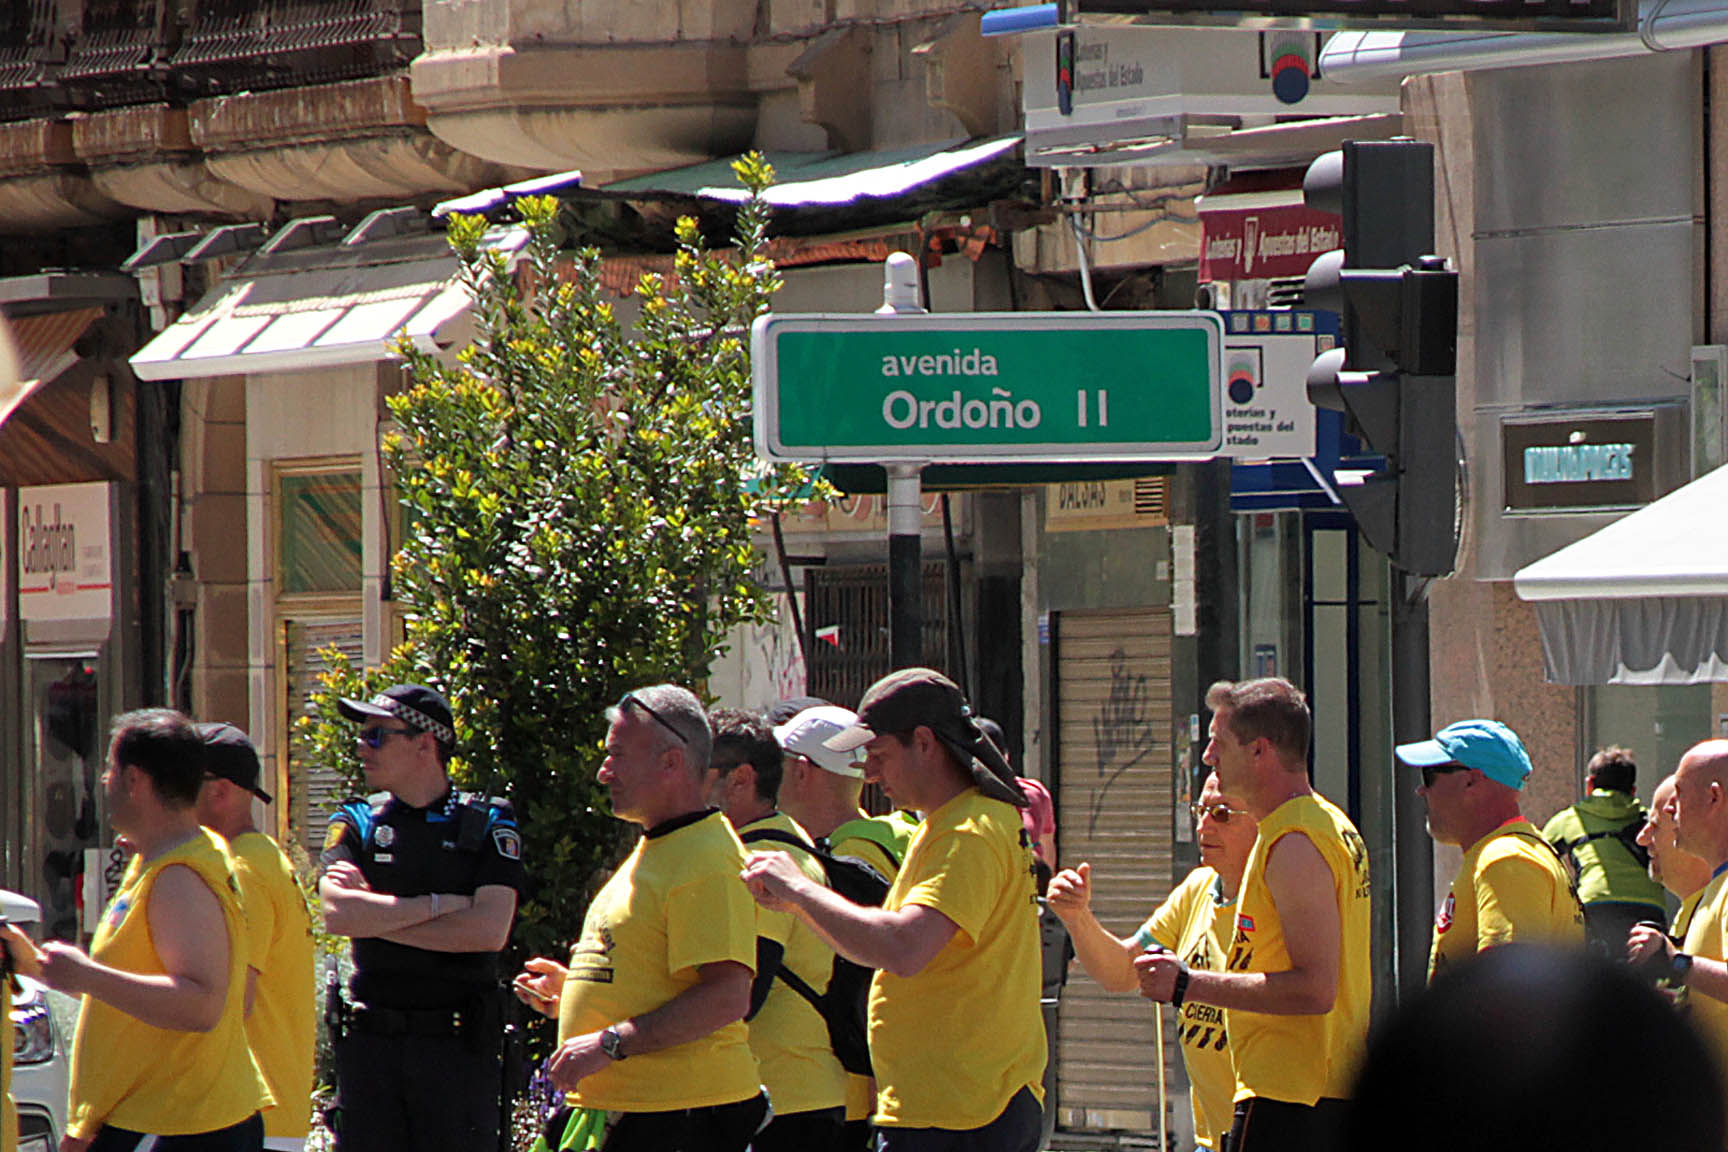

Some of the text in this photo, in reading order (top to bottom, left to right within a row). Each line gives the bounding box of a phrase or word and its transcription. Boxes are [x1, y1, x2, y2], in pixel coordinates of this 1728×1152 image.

[882, 349, 998, 376] avenida
[882, 387, 1108, 429] Ordoño II
[1227, 420, 1295, 433] puestas del
[1226, 435, 1259, 446] stado
